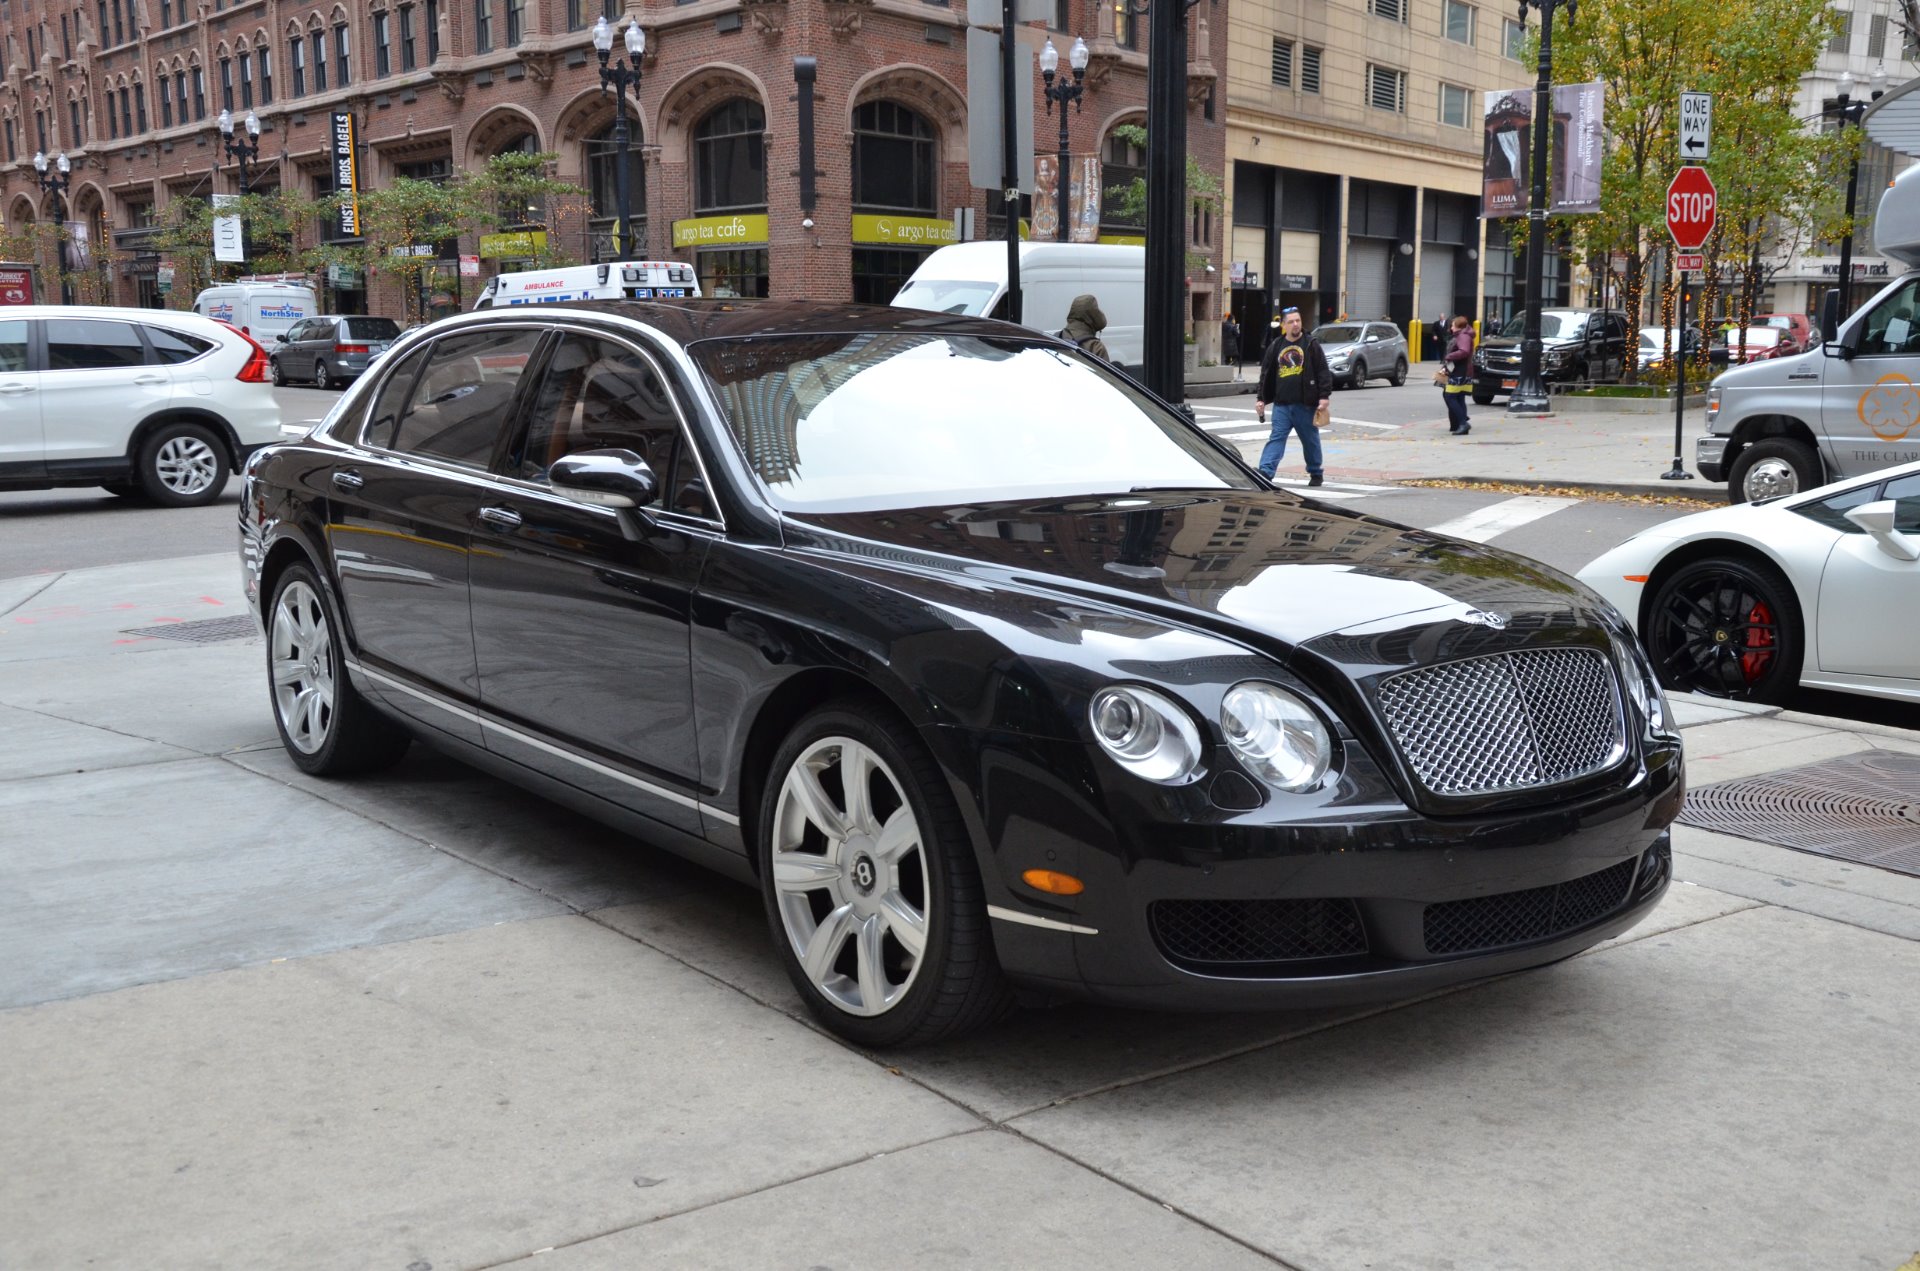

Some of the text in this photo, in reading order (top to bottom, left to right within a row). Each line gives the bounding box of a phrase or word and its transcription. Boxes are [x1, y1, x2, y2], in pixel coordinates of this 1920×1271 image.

[1684, 98, 1707, 115] ONE
[1585, 90, 1595, 167] Marcella Hackbardt
[1684, 117, 1707, 133] WAY
[336, 115, 350, 154] BAGELS
[339, 157, 353, 185] BROS.
[1492, 195, 1517, 203] LUMA
[1670, 192, 1713, 223] STOP
[682, 217, 746, 244] argo tea café
[898, 225, 924, 241] argo
[926, 225, 939, 239] tea
[415, 244, 433, 256] BAGELS
[1678, 257, 1702, 268] ALL WAY
[1870, 261, 1889, 275] rack
[524, 281, 564, 291] AMBULANCE
[260, 309, 304, 318] NorthStar
[1852, 450, 1920, 462] THE CLAR
